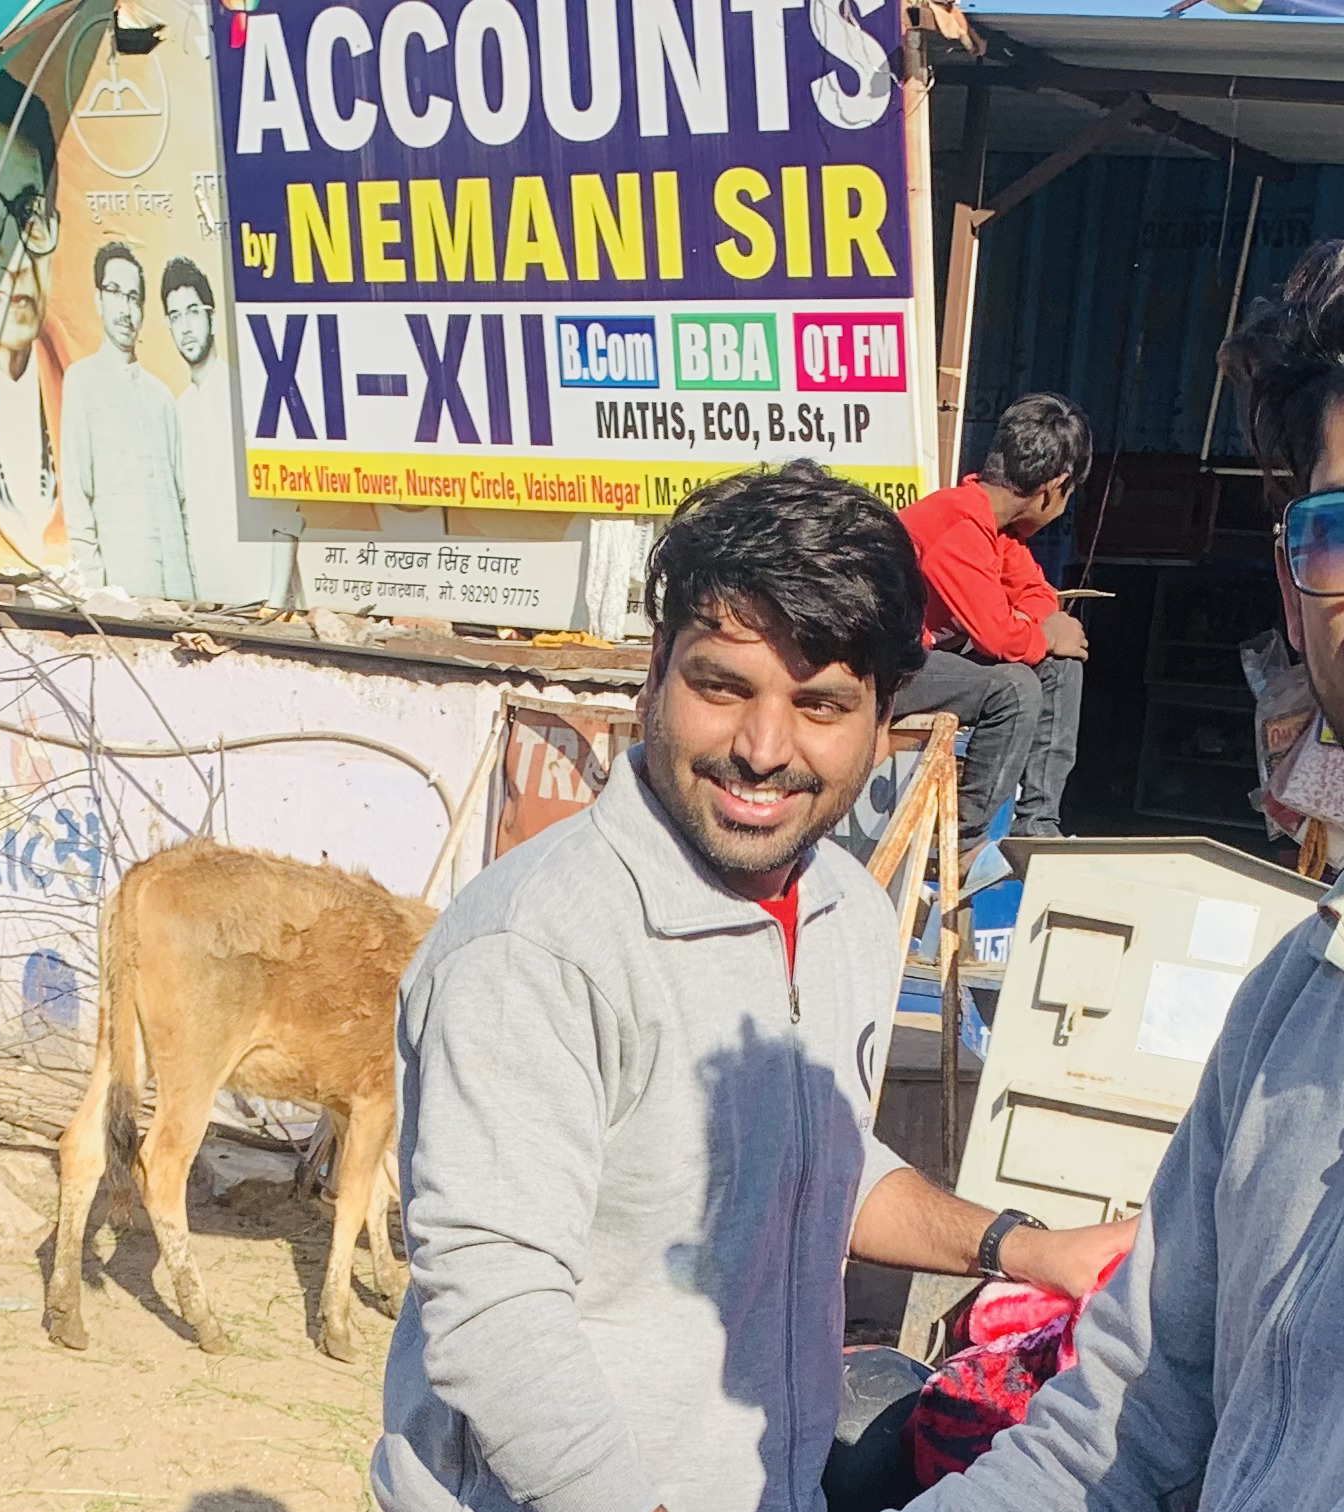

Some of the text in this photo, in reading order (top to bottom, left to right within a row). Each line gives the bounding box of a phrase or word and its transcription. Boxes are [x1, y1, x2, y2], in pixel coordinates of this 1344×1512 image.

[236, 0, 891, 155] ACCOUNTS
[241, 222, 276, 277] by
[286, 171, 684, 283] NEMANI
[713, 164, 897, 280] SIR
[247, 314, 553, 446] XI-XII
[560, 323, 654, 382] B.Com
[676, 322, 773, 383] BBA
[854, 323, 900, 380] FM
[596, 401, 870, 450] MATHS, ECO, B.St, IP
[253, 464, 277, 496] 97,
[280, 465, 312, 492] Park
[315, 466, 351, 494] View
[354, 467, 403, 501] Tower,
[406, 469, 466, 505] Nursery
[471, 471, 521, 505] Circle,
[524, 472, 586, 503] Vaishali
[591, 475, 641, 511] Nagar
[325, 541, 522, 576] मा. श्री लखन सिंह पंवार
[314, 573, 540, 607] प्रदेश प्रमुख राजस्थान, मो. 98290 97775
